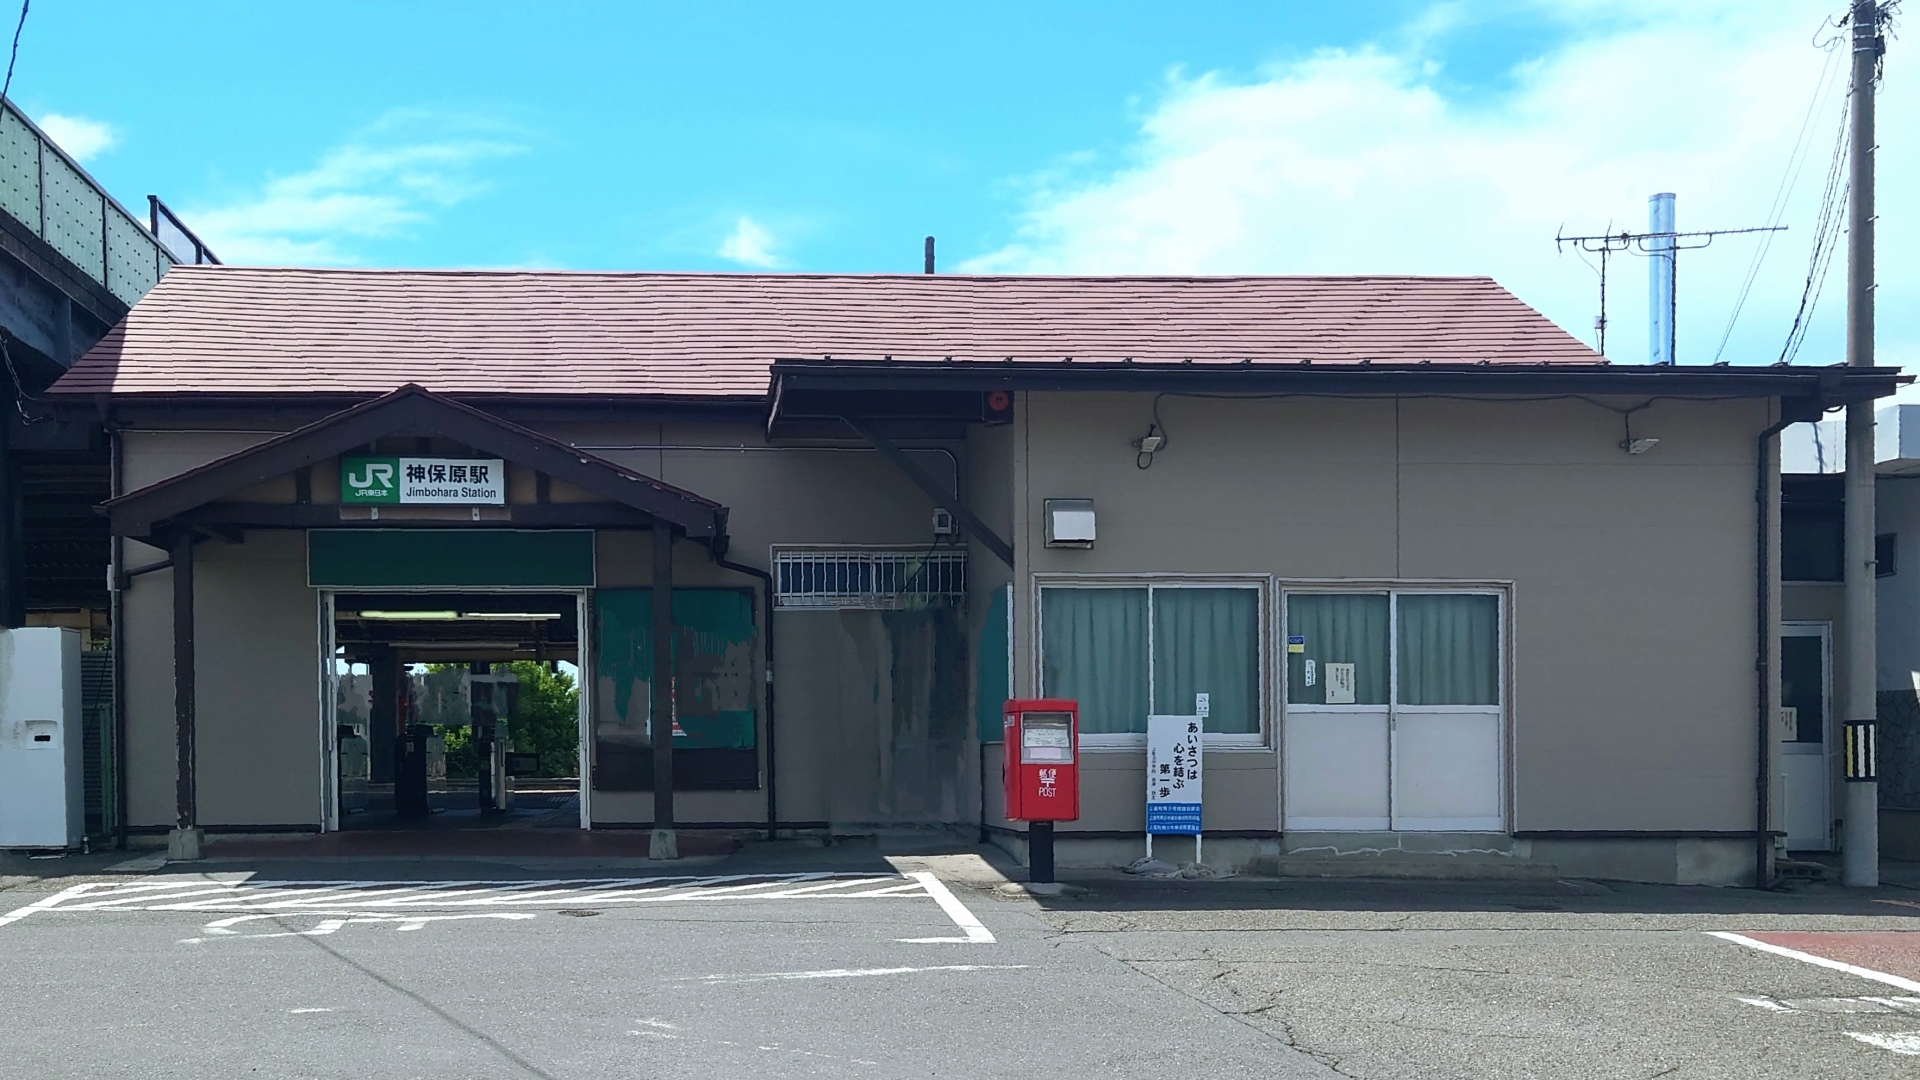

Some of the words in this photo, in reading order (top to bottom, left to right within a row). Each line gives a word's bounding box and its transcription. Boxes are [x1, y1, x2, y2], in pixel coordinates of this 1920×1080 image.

[349, 464, 393, 488] JR
[406, 464, 489, 484] 神保原駅
[355, 489, 388, 497] JR東日本
[406, 487, 458, 498] Jimbohara
[461, 488, 496, 498] Station
[1187, 721, 1198, 780] あいさつは
[1038, 768, 1057, 779] 郵便
[1173, 742, 1185, 789] 心を結ぶ
[1159, 763, 1171, 798] 第一歩
[1038, 787, 1057, 797] POST
